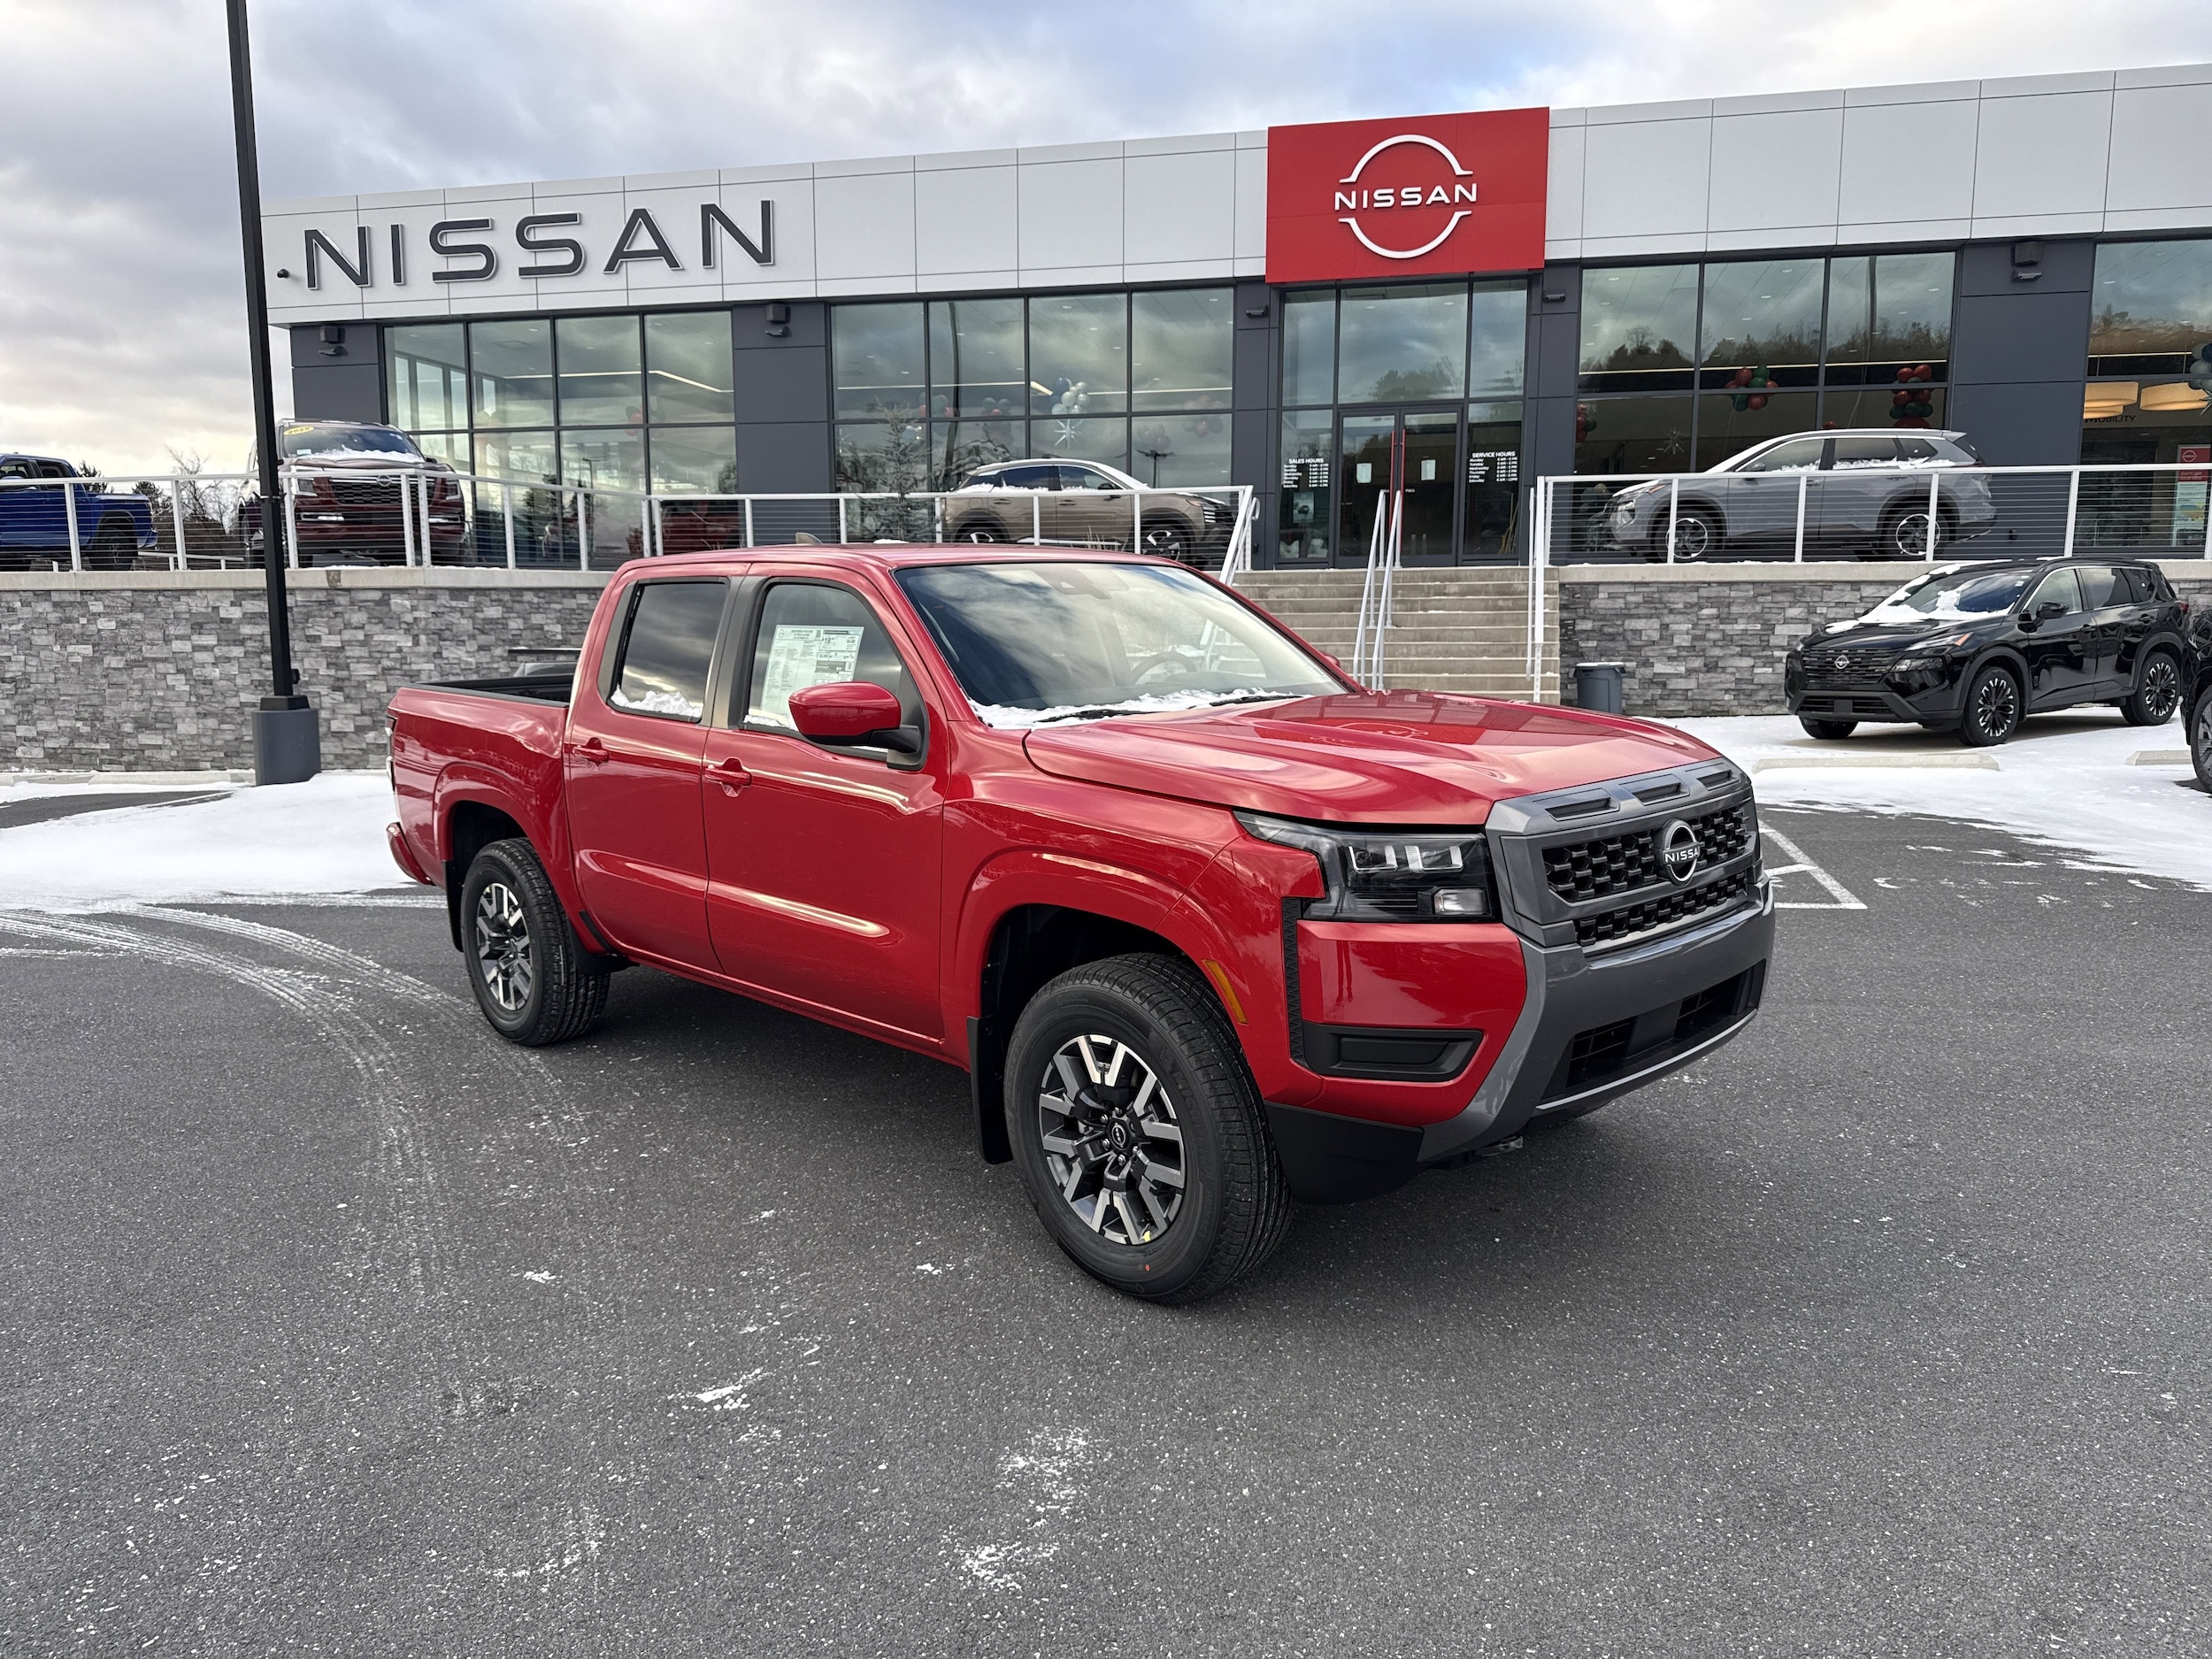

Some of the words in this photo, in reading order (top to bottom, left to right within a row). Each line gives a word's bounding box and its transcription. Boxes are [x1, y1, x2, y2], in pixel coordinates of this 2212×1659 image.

[1334, 183, 1477, 211] NISSAN
[304, 200, 774, 290] NISSAN
[1664, 847, 1699, 863] NISSA
